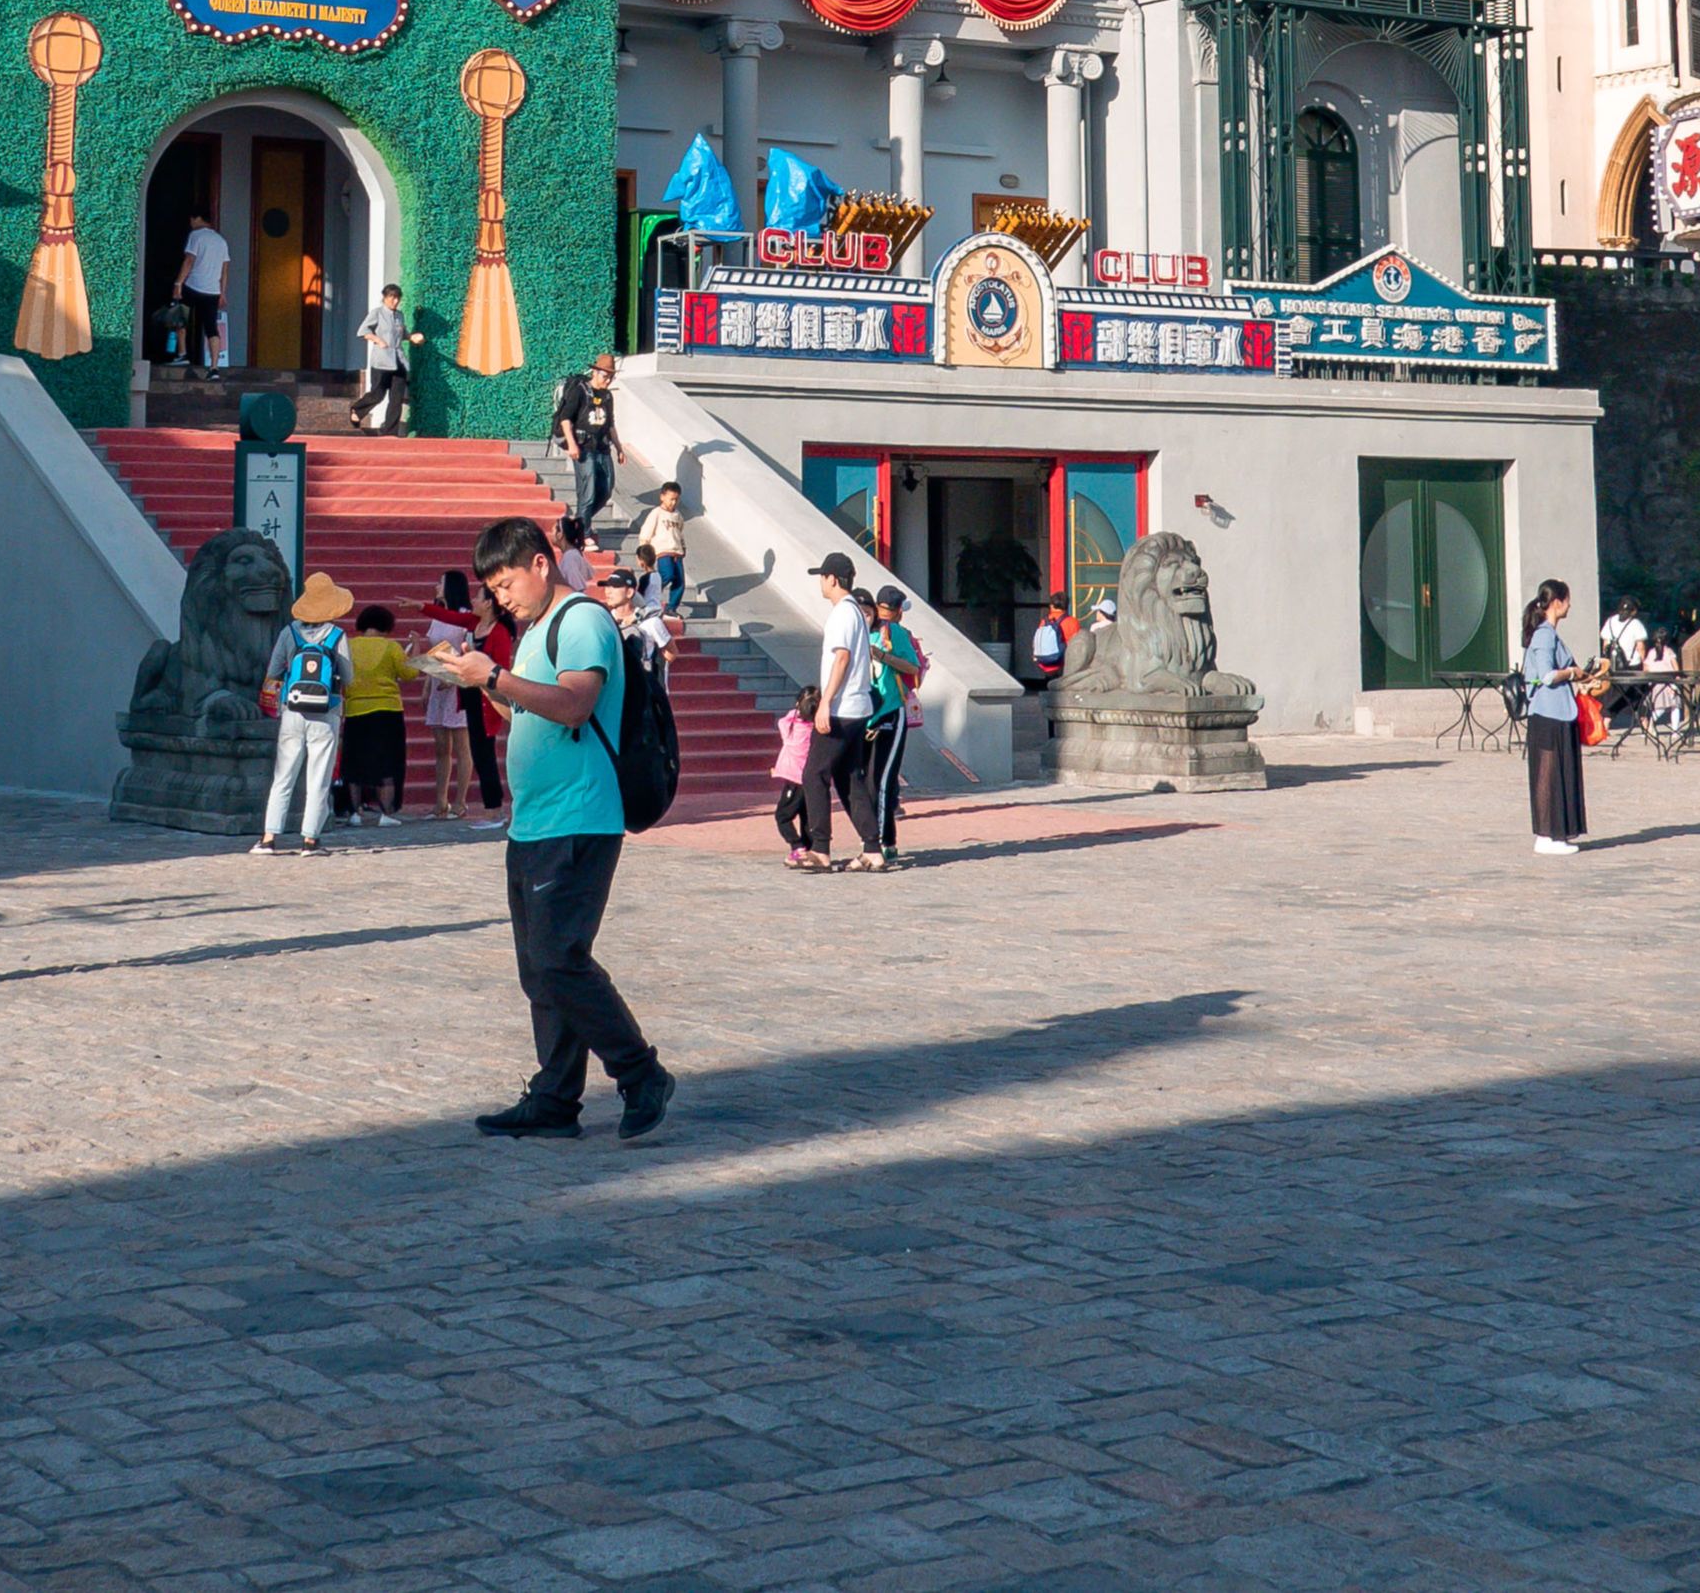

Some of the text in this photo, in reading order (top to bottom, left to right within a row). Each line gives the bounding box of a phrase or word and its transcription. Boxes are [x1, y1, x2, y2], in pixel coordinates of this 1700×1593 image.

[319, 5, 368, 25] MAJESTY
[757, 227, 893, 272] CLUB
[1094, 249, 1214, 288] CLUB
[970, 279, 1017, 310] APOSTOLATUS
[1280, 298, 1326, 314] HONG
[1328, 301, 1375, 317] KONG
[1455, 309, 1505, 324] UNION
